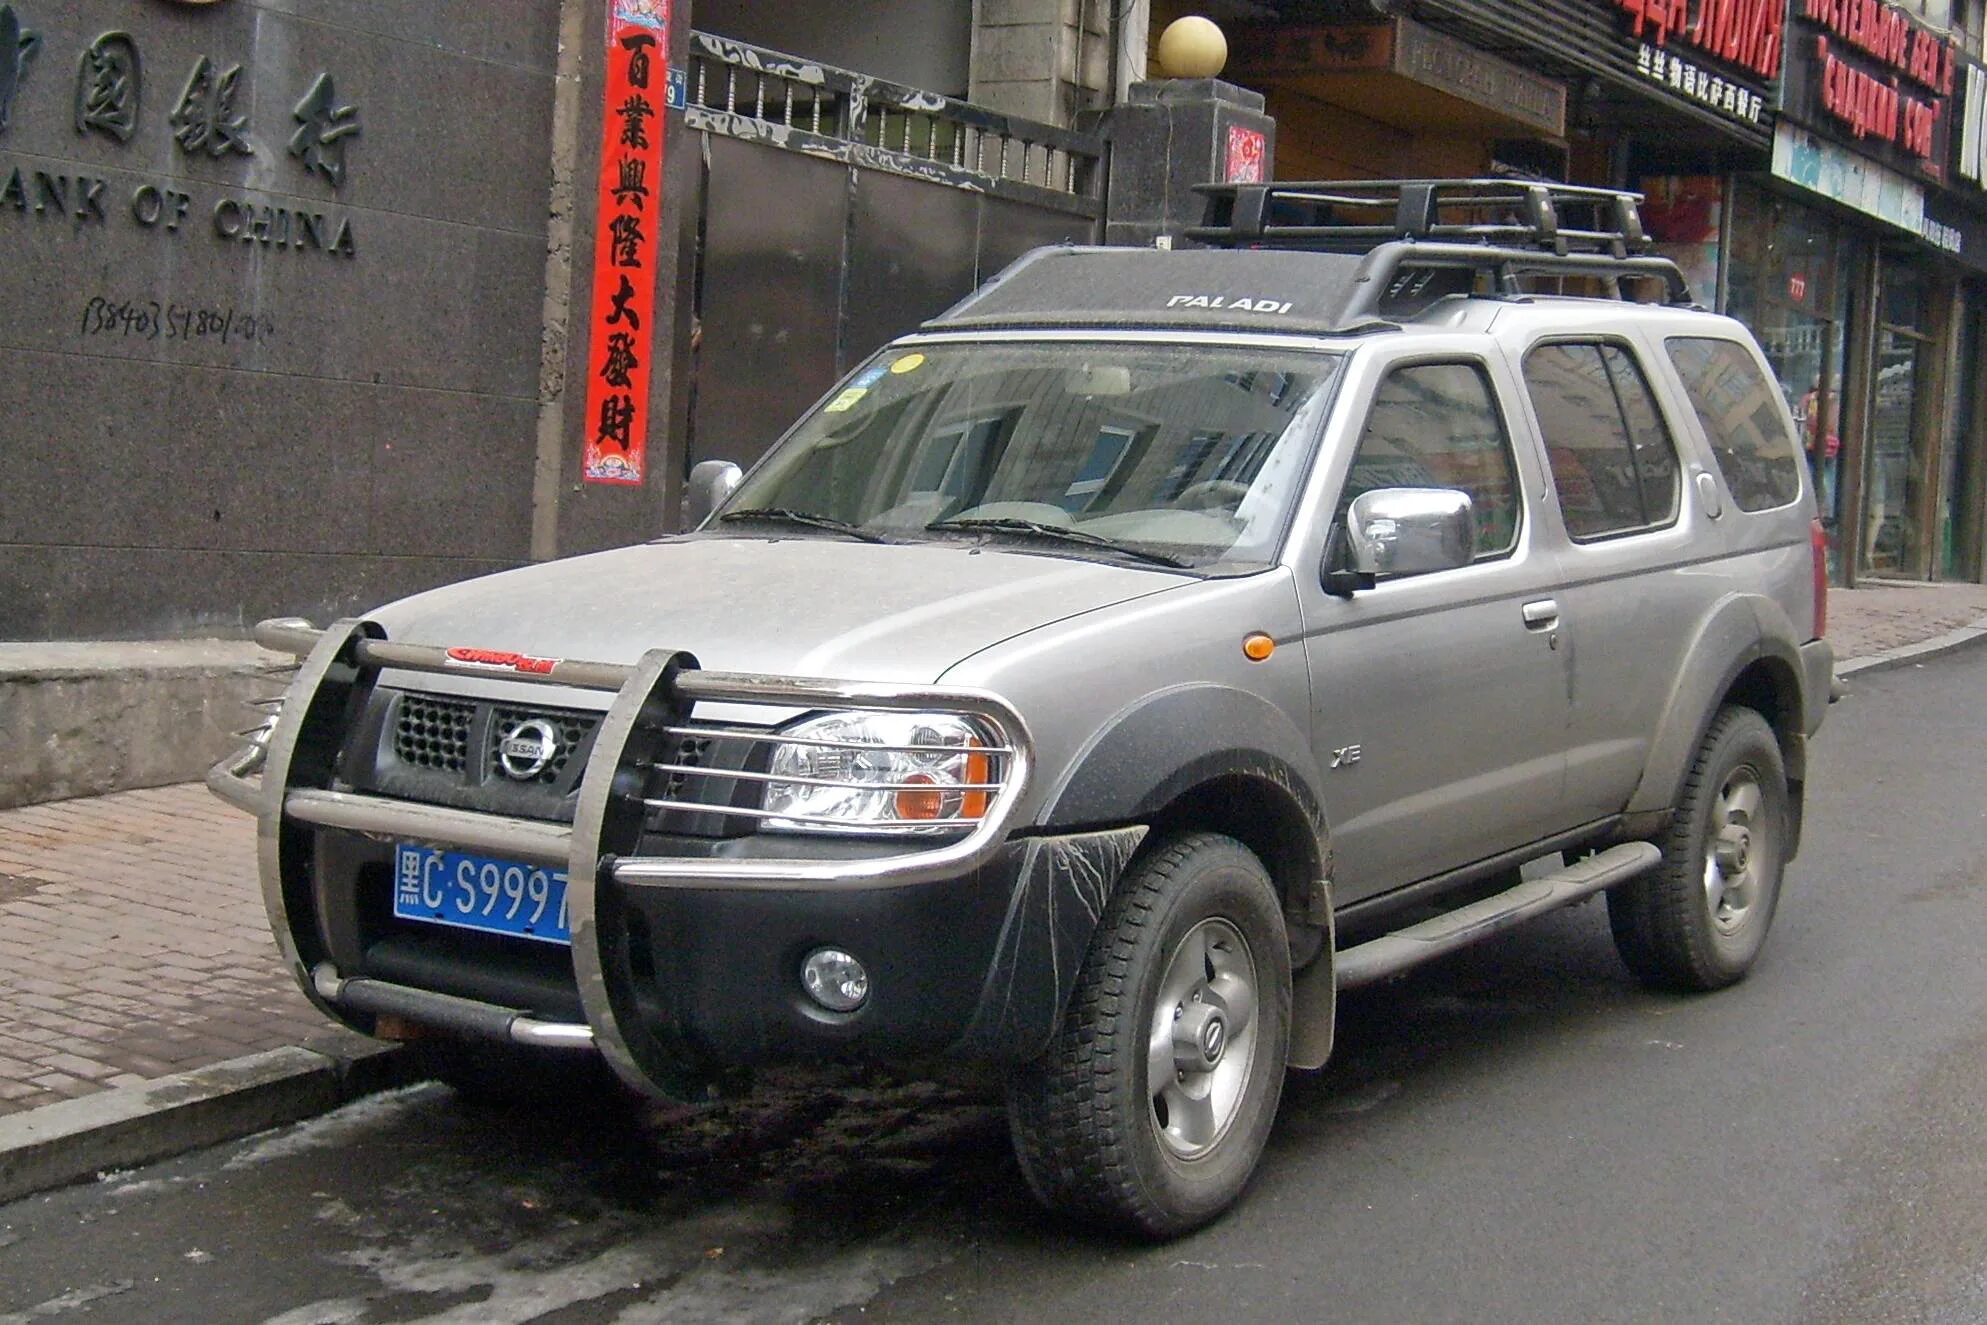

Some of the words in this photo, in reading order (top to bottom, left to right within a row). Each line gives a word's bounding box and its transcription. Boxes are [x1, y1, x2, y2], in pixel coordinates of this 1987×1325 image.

[133, 184, 191, 233] OF
[213, 199, 356, 257] CHINA
[595, 33, 657, 451] 百業興隆大發財
[1166, 295, 1293, 314] PALADI
[1331, 744, 1361, 768] XE
